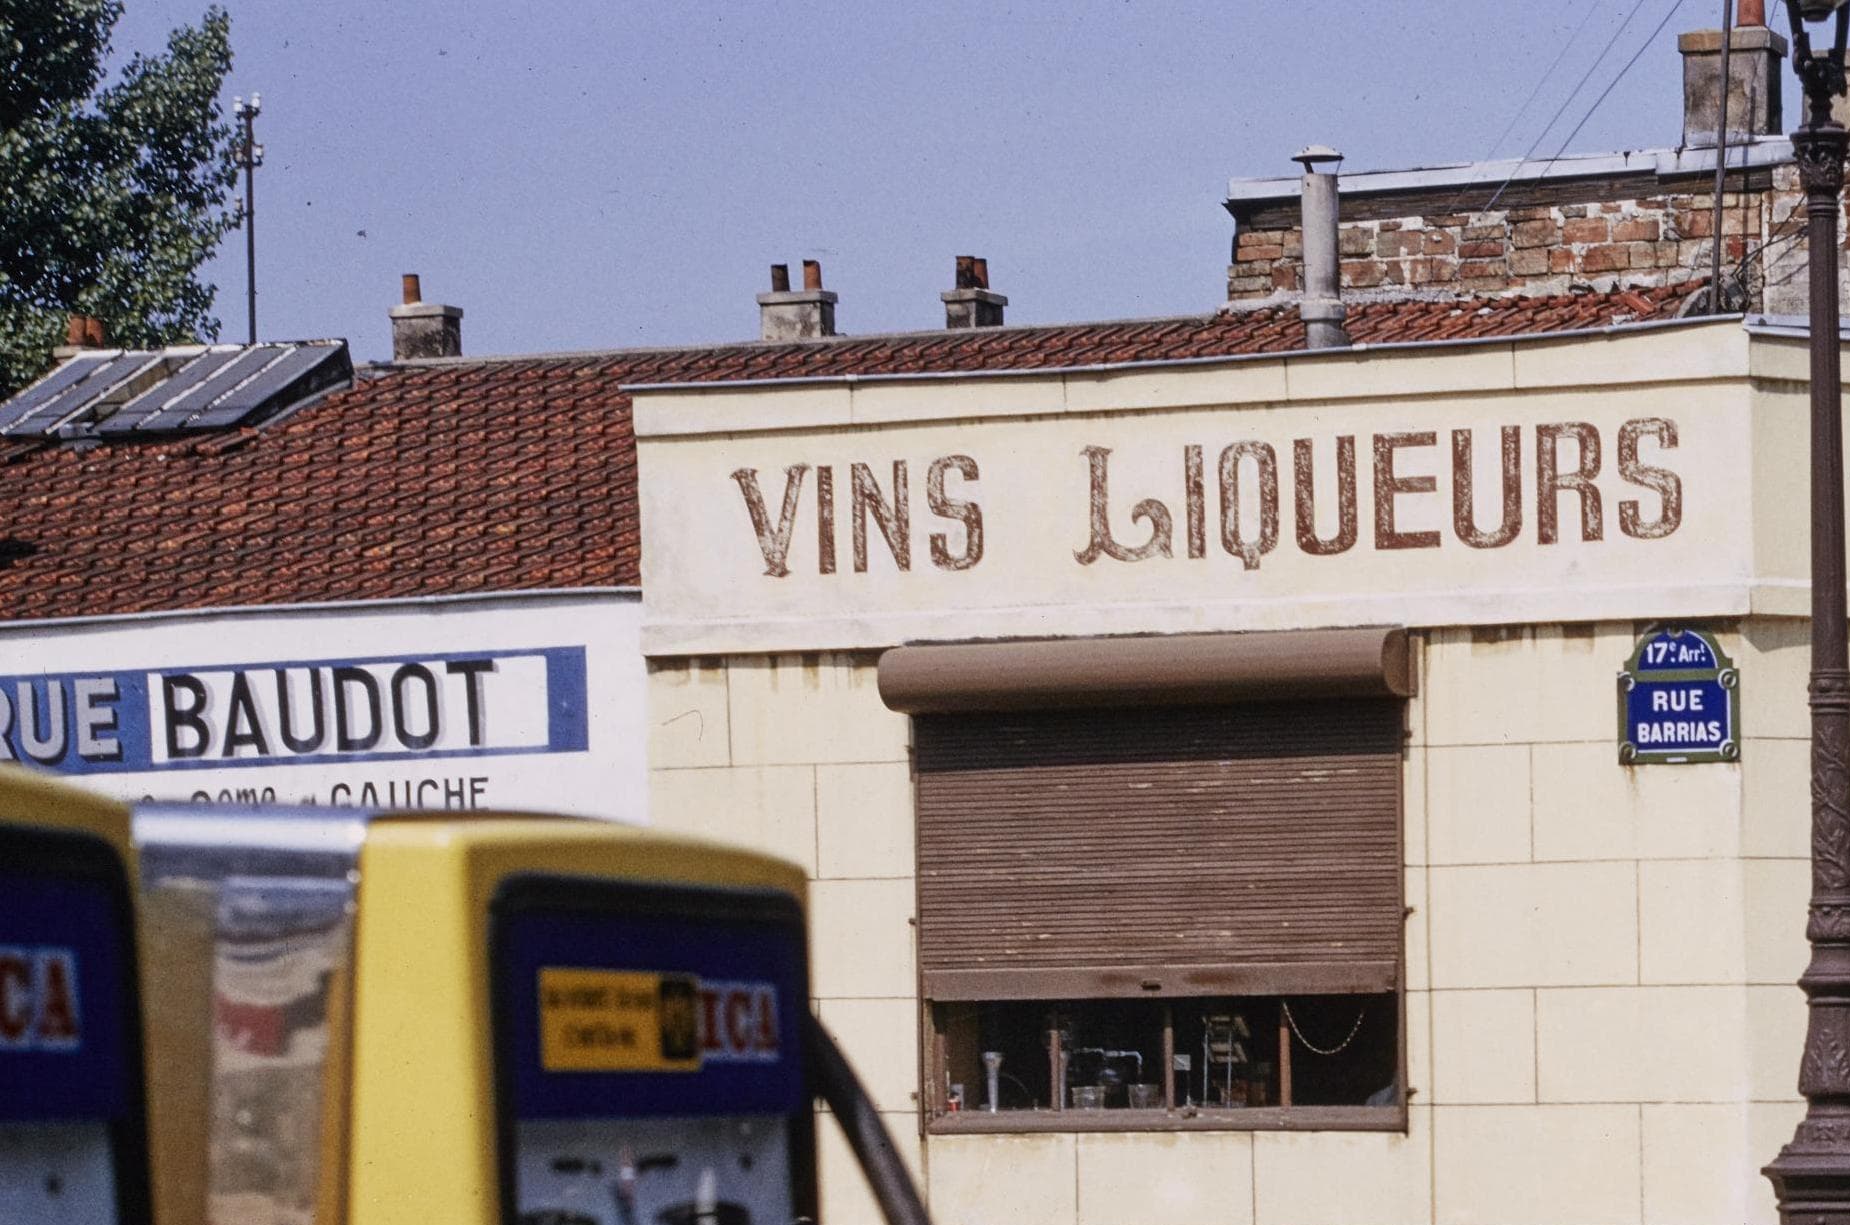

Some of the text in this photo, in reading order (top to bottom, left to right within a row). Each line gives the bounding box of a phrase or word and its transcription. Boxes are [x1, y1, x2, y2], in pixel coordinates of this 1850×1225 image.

[729, 417, 1683, 578] VINS LIQUEURS
[161, 659, 498, 759] BAUDOT
[1652, 689, 1704, 712] RUE
[1637, 721, 1721, 743] BARRIAS
